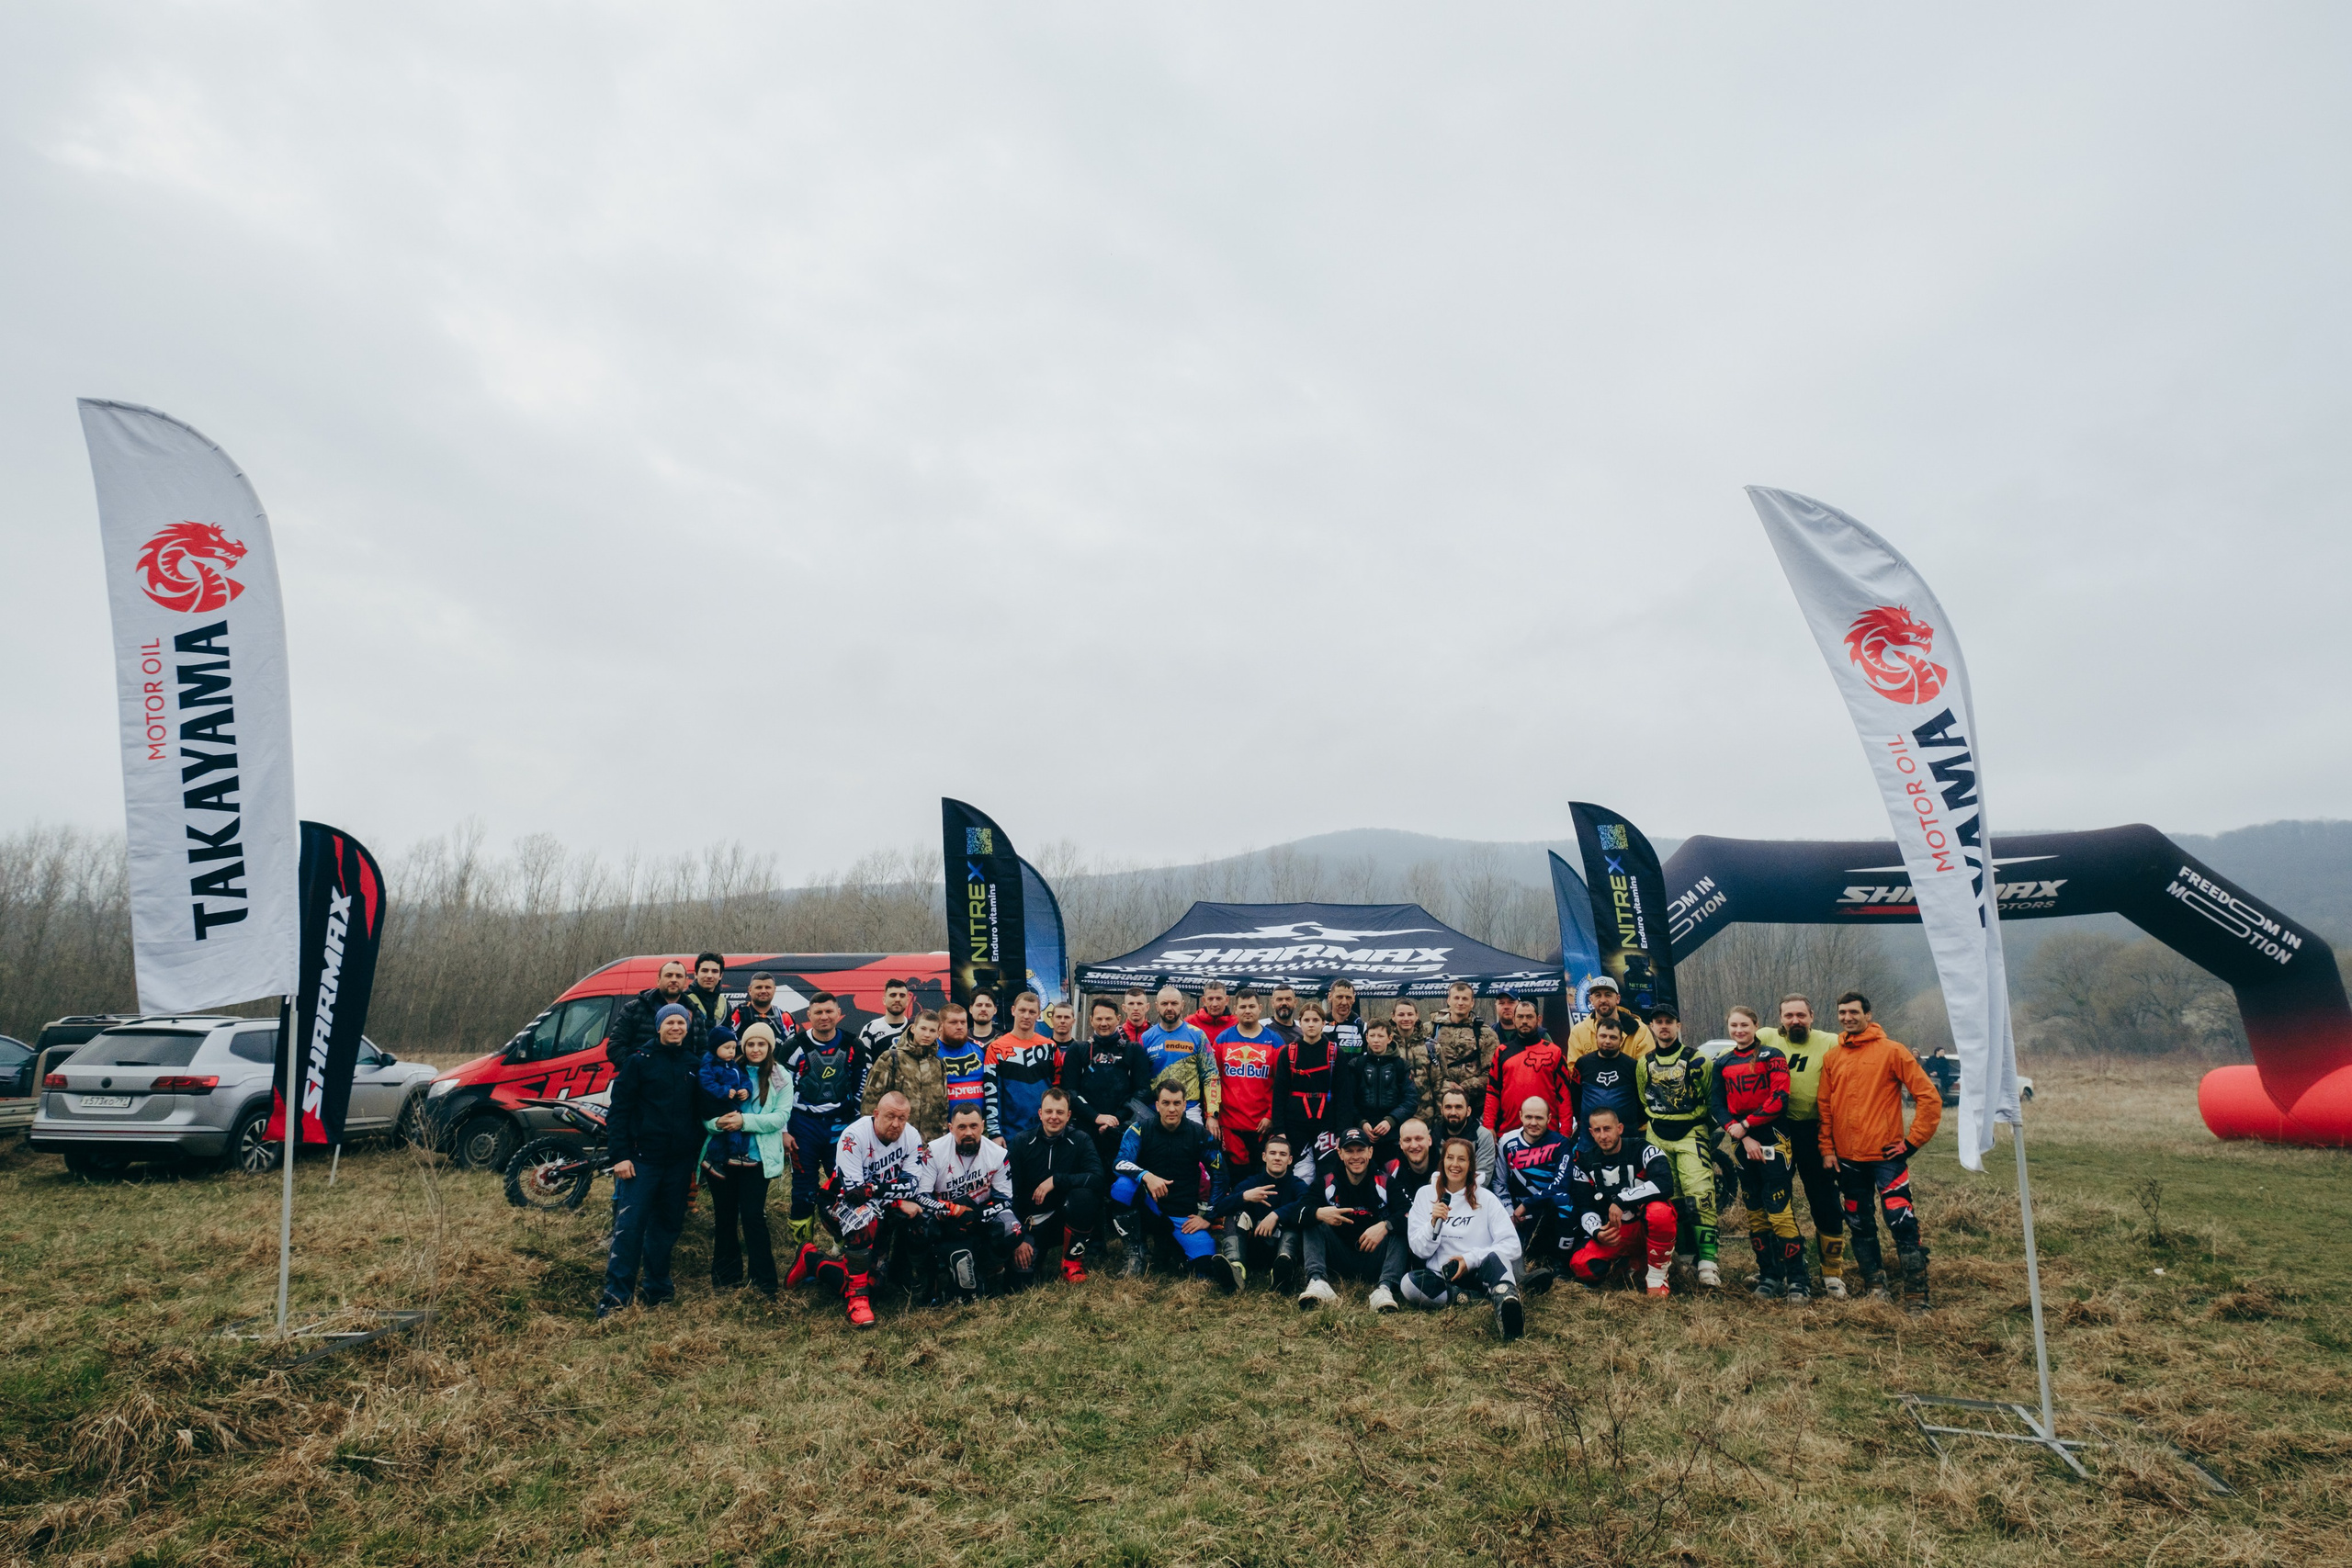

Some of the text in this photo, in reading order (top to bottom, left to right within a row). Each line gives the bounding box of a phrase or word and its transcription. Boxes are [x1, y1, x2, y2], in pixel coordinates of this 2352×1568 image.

[141, 637, 167, 761] MOTOR OIL
[174, 619, 249, 942] TAKAYAMA
[1887, 733, 1955, 873] MOTOR OIL
[967, 859, 989, 963] NITREX
[988, 883, 1000, 963] Enduro vitamins
[1604, 854, 1639, 950] NITREX
[1630, 874, 1649, 950] Enduro vitamins
[1694, 874, 1716, 897] IN
[2165, 880, 2292, 965] MOTION
[2178, 865, 2302, 950] FREEDOM IN
[1083, 971, 1159, 983] SHARMAX
[1150, 943, 1454, 964] SHARMAX
[1341, 963, 1445, 974] RACE
[1488, 979, 1562, 989] SHARMAX
[1628, 981, 1653, 989] NITREX
[301, 885, 353, 1120] SHARMAX
[1165, 1043, 1193, 1051] enduro
[1224, 1062, 1270, 1079] Red Bull
[1452, 1215, 1476, 1227] CAT
